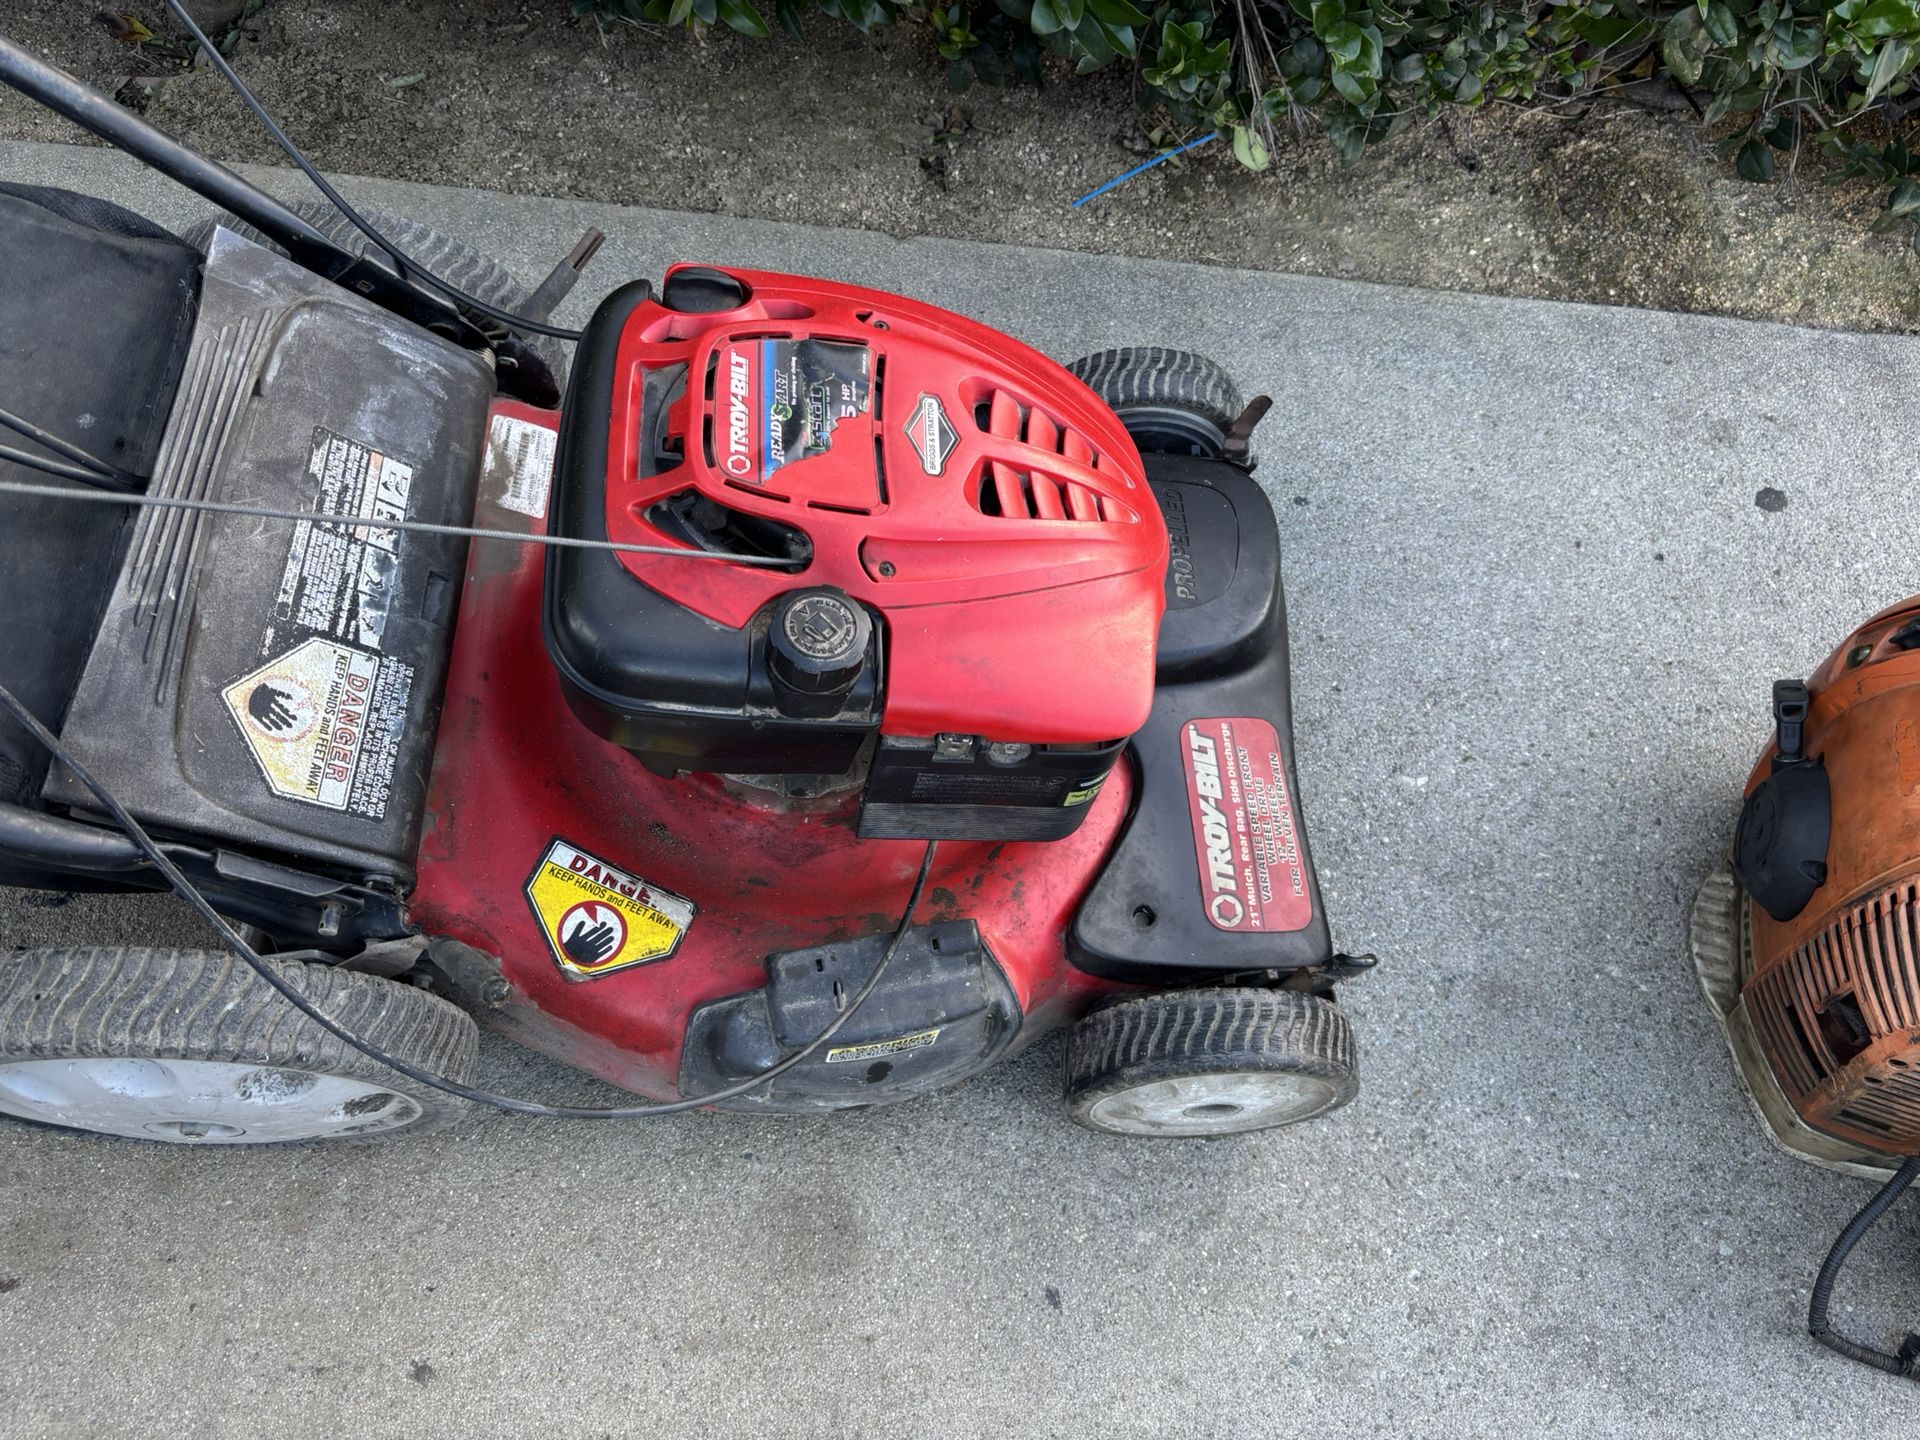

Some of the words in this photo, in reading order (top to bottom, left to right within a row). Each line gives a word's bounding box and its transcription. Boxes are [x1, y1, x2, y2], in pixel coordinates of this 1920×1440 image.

[730, 352, 749, 453] TROY-BILT
[841, 383, 849, 400] HP
[926, 402, 934, 436] STRATTON
[928, 444, 936, 470] BRIGGS
[1166, 488, 1197, 602] PROPELLED
[332, 653, 348, 679] KEEP
[381, 657, 389, 666] IF
[385, 659, 397, 684] GRASS
[323, 680, 342, 716] HANDS
[378, 684, 392, 719] CATCHER
[384, 698, 398, 731] UNLESS
[319, 716, 333, 735] and
[325, 673, 370, 783] DANGER
[362, 710, 377, 750] REPLACE
[376, 720, 384, 728] IS
[312, 736, 329, 762] FEET
[370, 738, 381, 752] ITS
[375, 731, 391, 775] DISCHARGE
[388, 743, 398, 755] OF
[1220, 722, 1236, 778] Discharge
[305, 762, 322, 793] AWAY
[364, 752, 377, 784] PROPER
[1238, 745, 1252, 788] FRONT
[1270, 751, 1288, 807] TERRAIN
[369, 775, 382, 803] COVER
[378, 787, 388, 800] DO
[1229, 778, 1240, 803] Side
[1254, 776, 1268, 815] DRIVE
[366, 803, 376, 816] OR
[374, 800, 385, 818] NOT
[1189, 727, 1236, 893] TROY-BILT
[1246, 791, 1261, 834] SPEED
[1267, 783, 1283, 836] WHEELS
[1237, 833, 1250, 862] Rear
[1261, 819, 1277, 865] WHEEL
[1280, 810, 1298, 864] UNEVEN
[568, 854, 657, 908] DANGE
[1253, 837, 1272, 902] VARIABLE
[1289, 867, 1303, 897] FOR
[548, 865, 574, 884] KEEP
[573, 876, 607, 899] HANDS
[606, 892, 624, 907] and
[623, 900, 649, 918] FEET
[647, 911, 675, 930] AWAY
